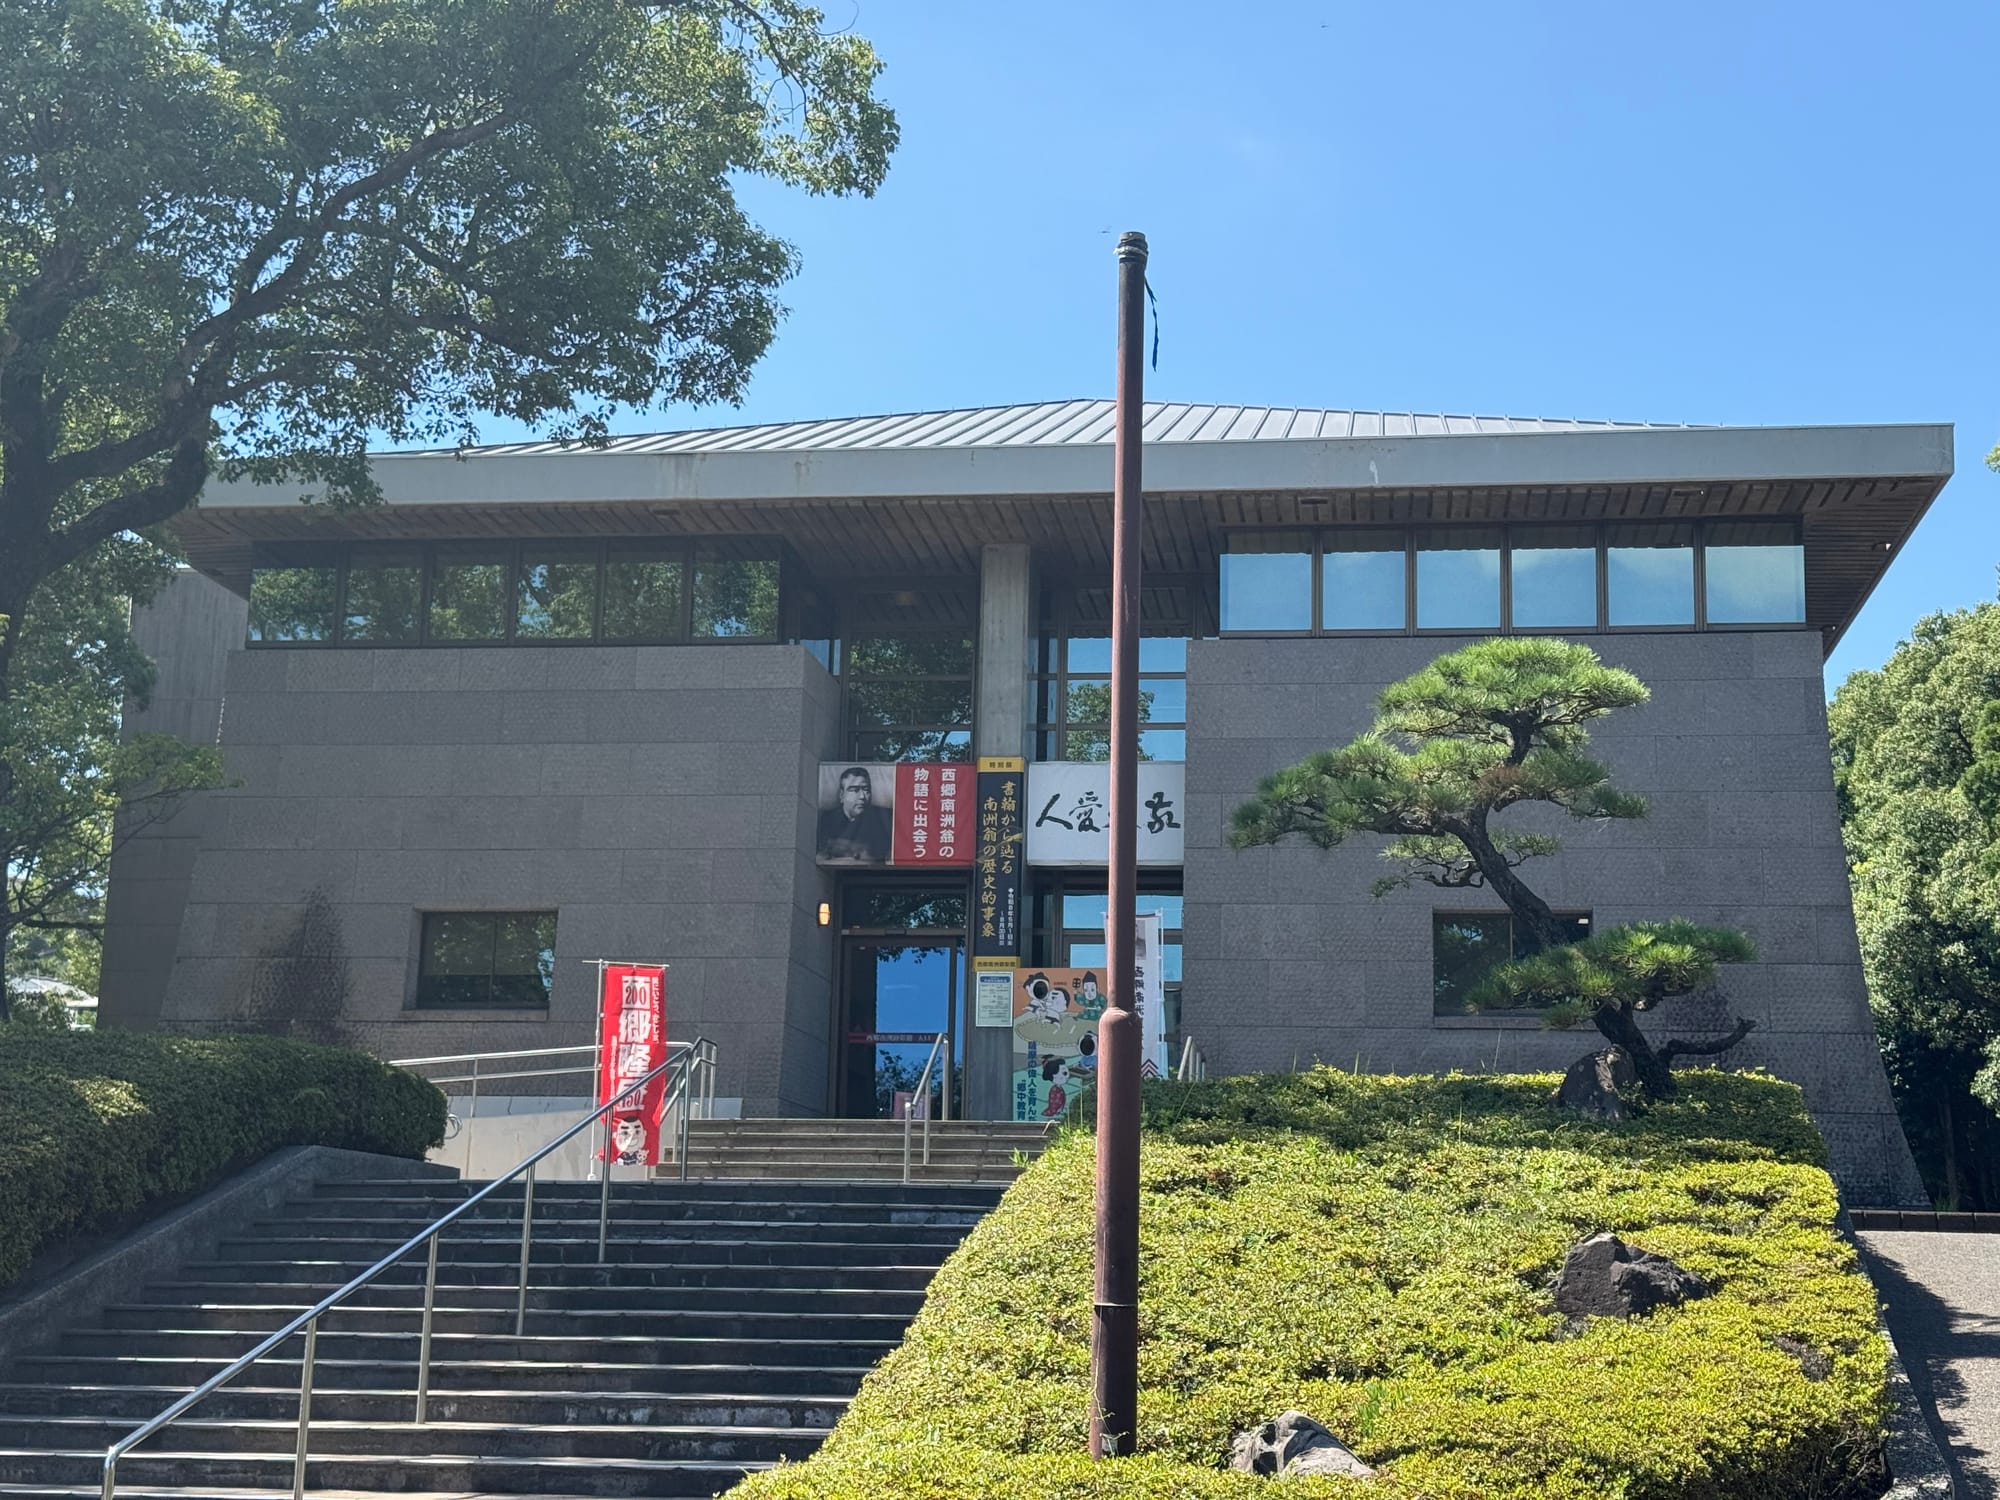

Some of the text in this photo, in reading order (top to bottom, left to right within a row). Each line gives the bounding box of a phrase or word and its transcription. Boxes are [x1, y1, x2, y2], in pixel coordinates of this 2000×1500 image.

[912, 767, 930, 858] 物語に出会う
[939, 768, 957, 858] 西郷南洲翁の
